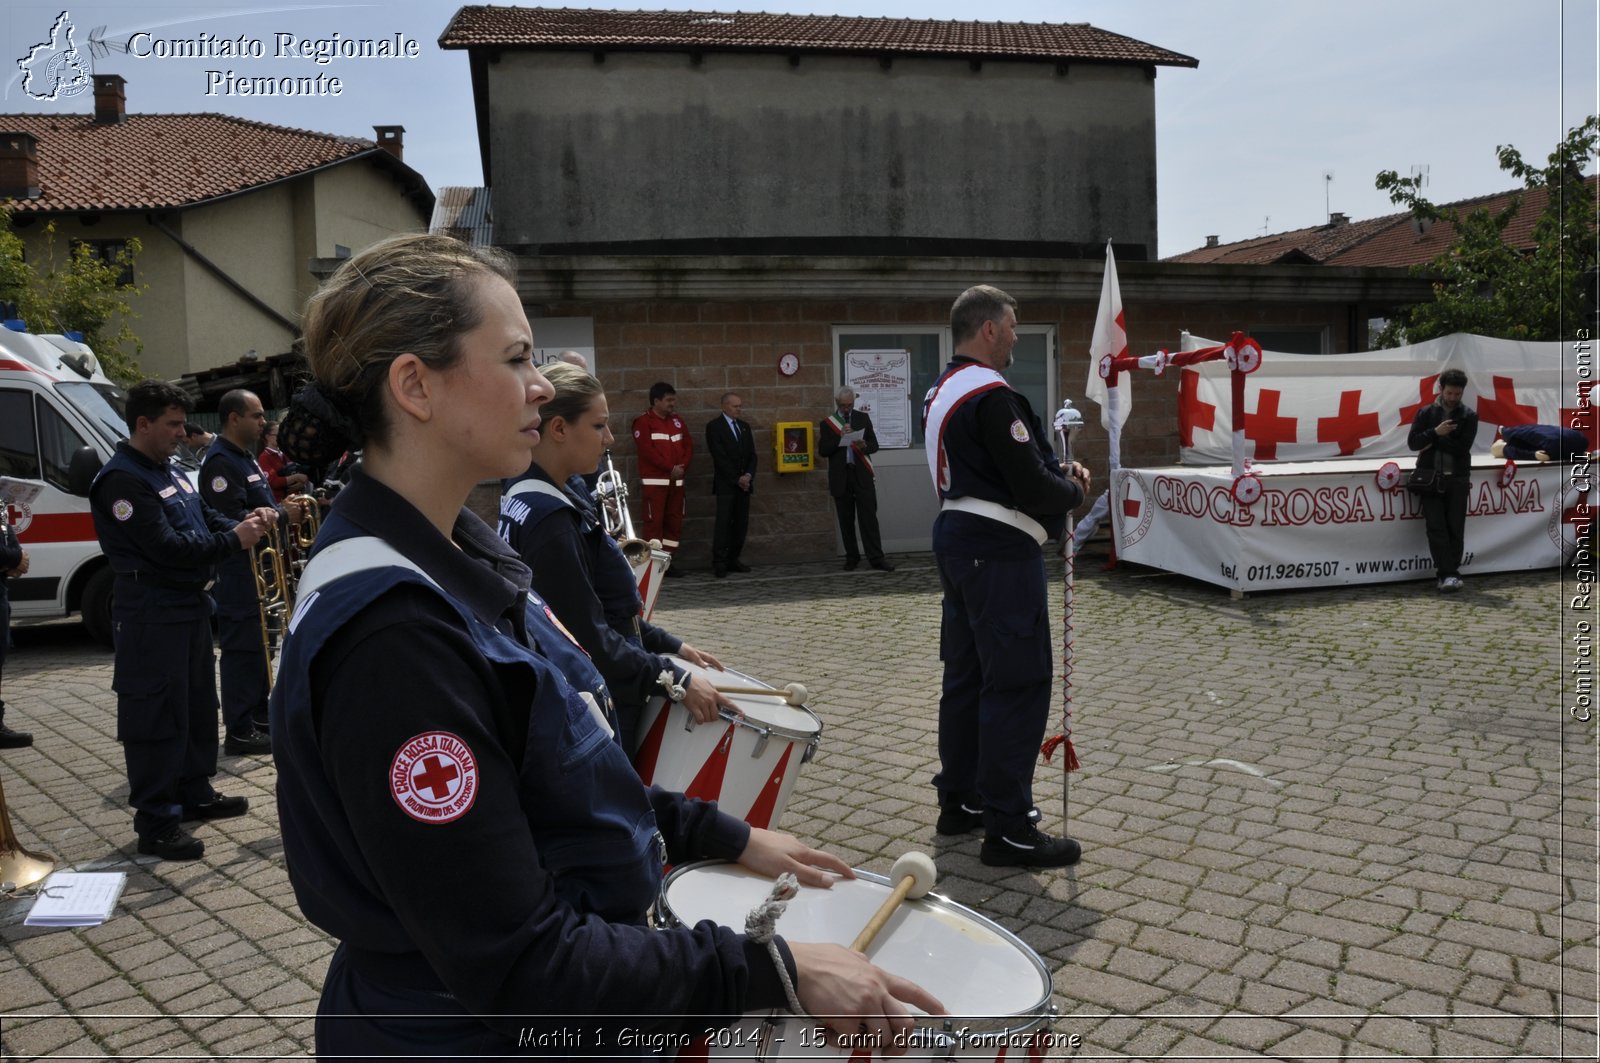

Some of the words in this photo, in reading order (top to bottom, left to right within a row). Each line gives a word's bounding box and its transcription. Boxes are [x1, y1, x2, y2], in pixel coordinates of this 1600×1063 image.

[1261, 486, 1375, 527] ROSSA
[1220, 562, 1240, 581] tel.
[1247, 561, 1340, 581] 011.9267507
[394, 757, 411, 795] CROCE
[403, 736, 438, 761] ROSSA
[440, 737, 474, 774] ITALIANA
[444, 804, 457, 817] DEL
